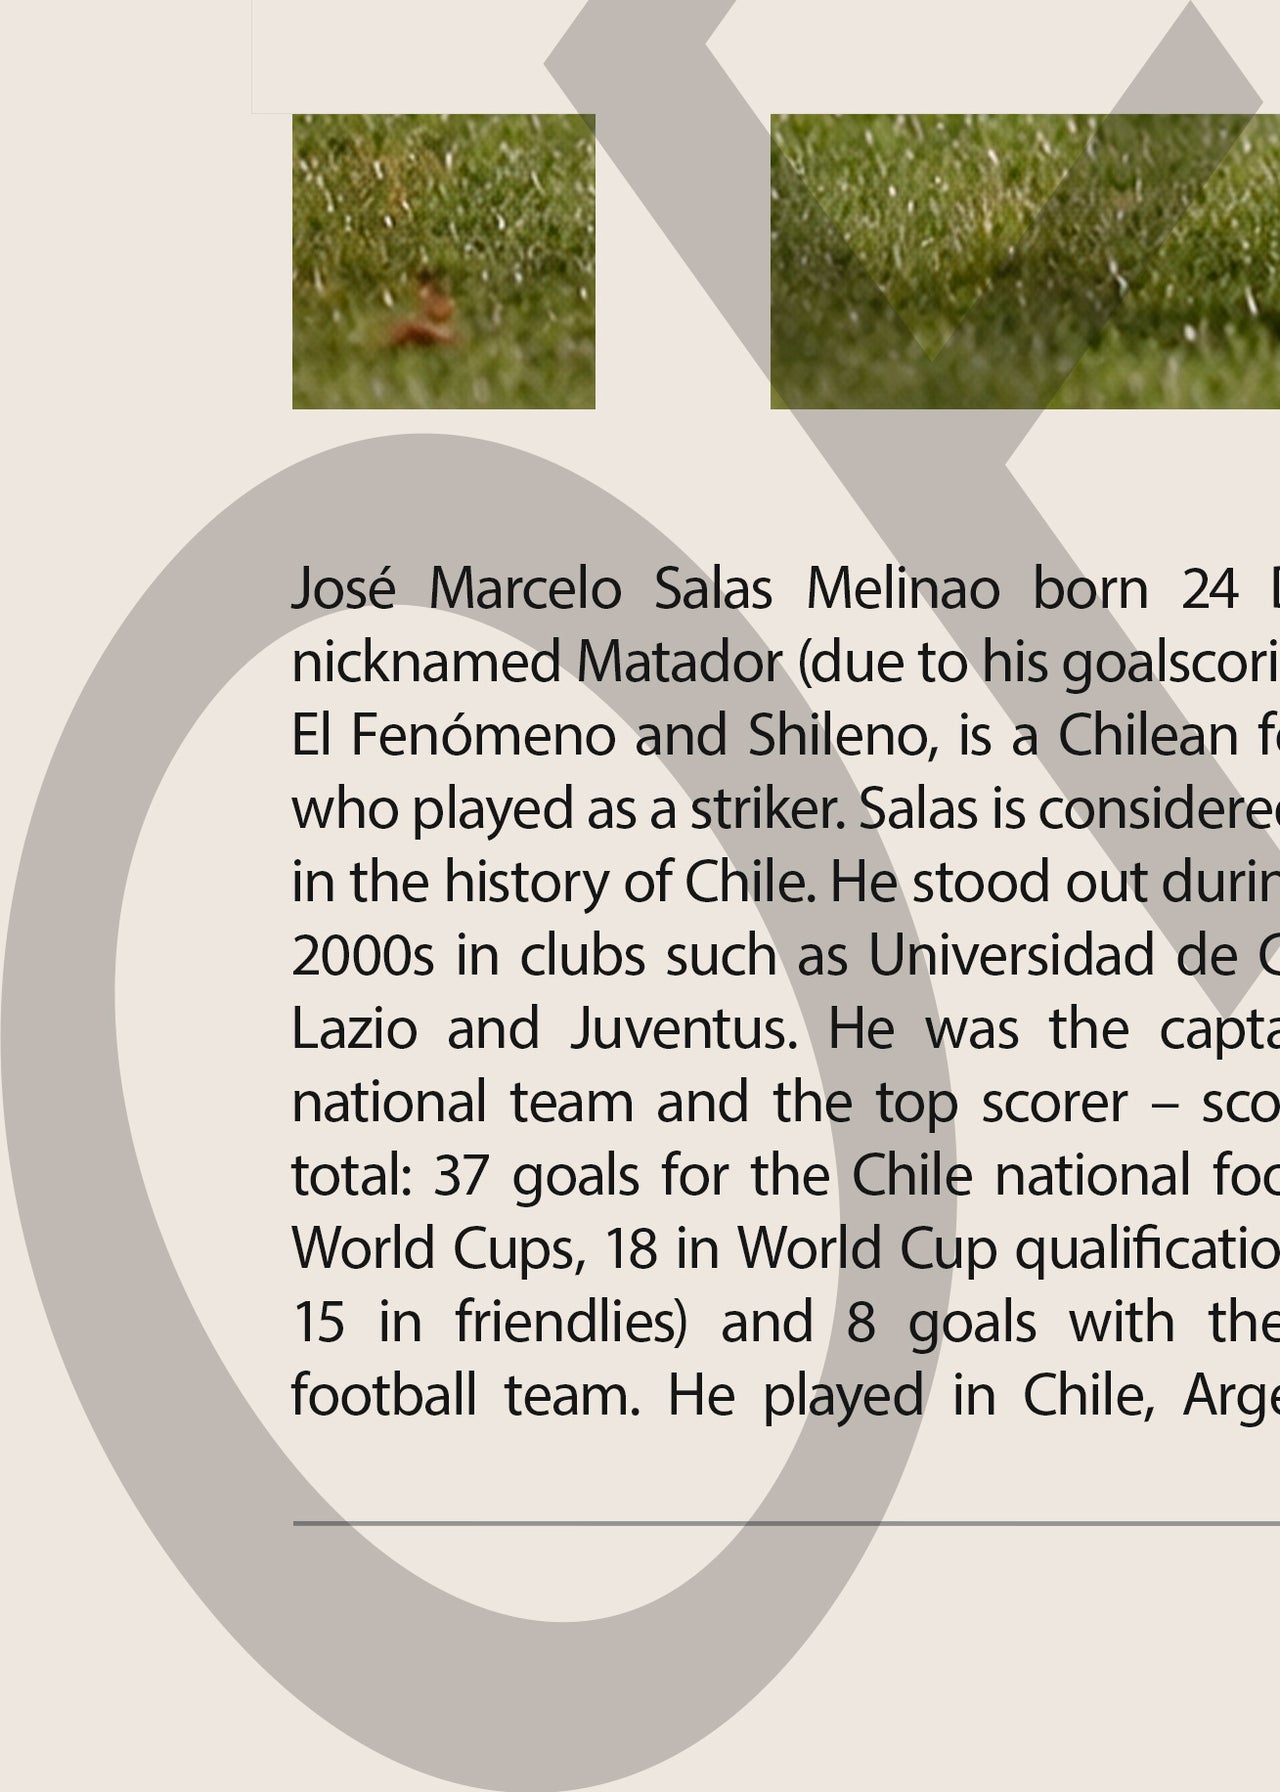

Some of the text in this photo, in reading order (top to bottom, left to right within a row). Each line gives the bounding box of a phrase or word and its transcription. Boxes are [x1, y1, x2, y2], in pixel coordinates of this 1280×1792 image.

[290, 565, 396, 610] José
[430, 563, 622, 610] Marcelo
[655, 563, 773, 610] Salas
[808, 563, 1000, 610] Melinao
[1035, 563, 1147, 610] born
[1182, 567, 1240, 609] 24
[294, 636, 560, 683] nicknamed
[578, 636, 784, 683] Matador
[799, 636, 904, 689] (due
[917, 642, 968, 683] to
[984, 636, 1048, 683] his
[291, 783, 399, 830] who
[414, 783, 572, 841] played
[588, 797, 637, 830] as
[650, 797, 676, 830] a
[691, 783, 845, 830] striker.
[859, 783, 978, 830] Salas
[994, 785, 1026, 830] is
[292, 934, 434, 976] 2000s
[458, 932, 498, 976] in
[521, 930, 645, 977] clubs
[667, 930, 776, 977] such
[798, 943, 848, 977] as
[871, 930, 1153, 977] Universidad
[1177, 929, 1238, 977] de
[294, 1005, 418, 1050] Lazio
[448, 1003, 538, 1050] and
[570, 1005, 797, 1050] Juventus.
[831, 1005, 895, 1050] He
[924, 1017, 1019, 1050] was
[1048, 1003, 1129, 1050] the
[291, 1223, 434, 1270] World
[454, 1225, 585, 1281] Cups,
[607, 1227, 657, 1270] 18
[678, 1225, 718, 1269] in
[737, 1223, 881, 1270] World
[901, 1225, 997, 1281] Cup
[290, 1370, 475, 1417] football
[503, 1375, 640, 1417] team.
[671, 1372, 735, 1416] He
[765, 1370, 923, 1428] played
[954, 1372, 995, 1416] in
[1024, 1370, 1155, 1423] Chile,
